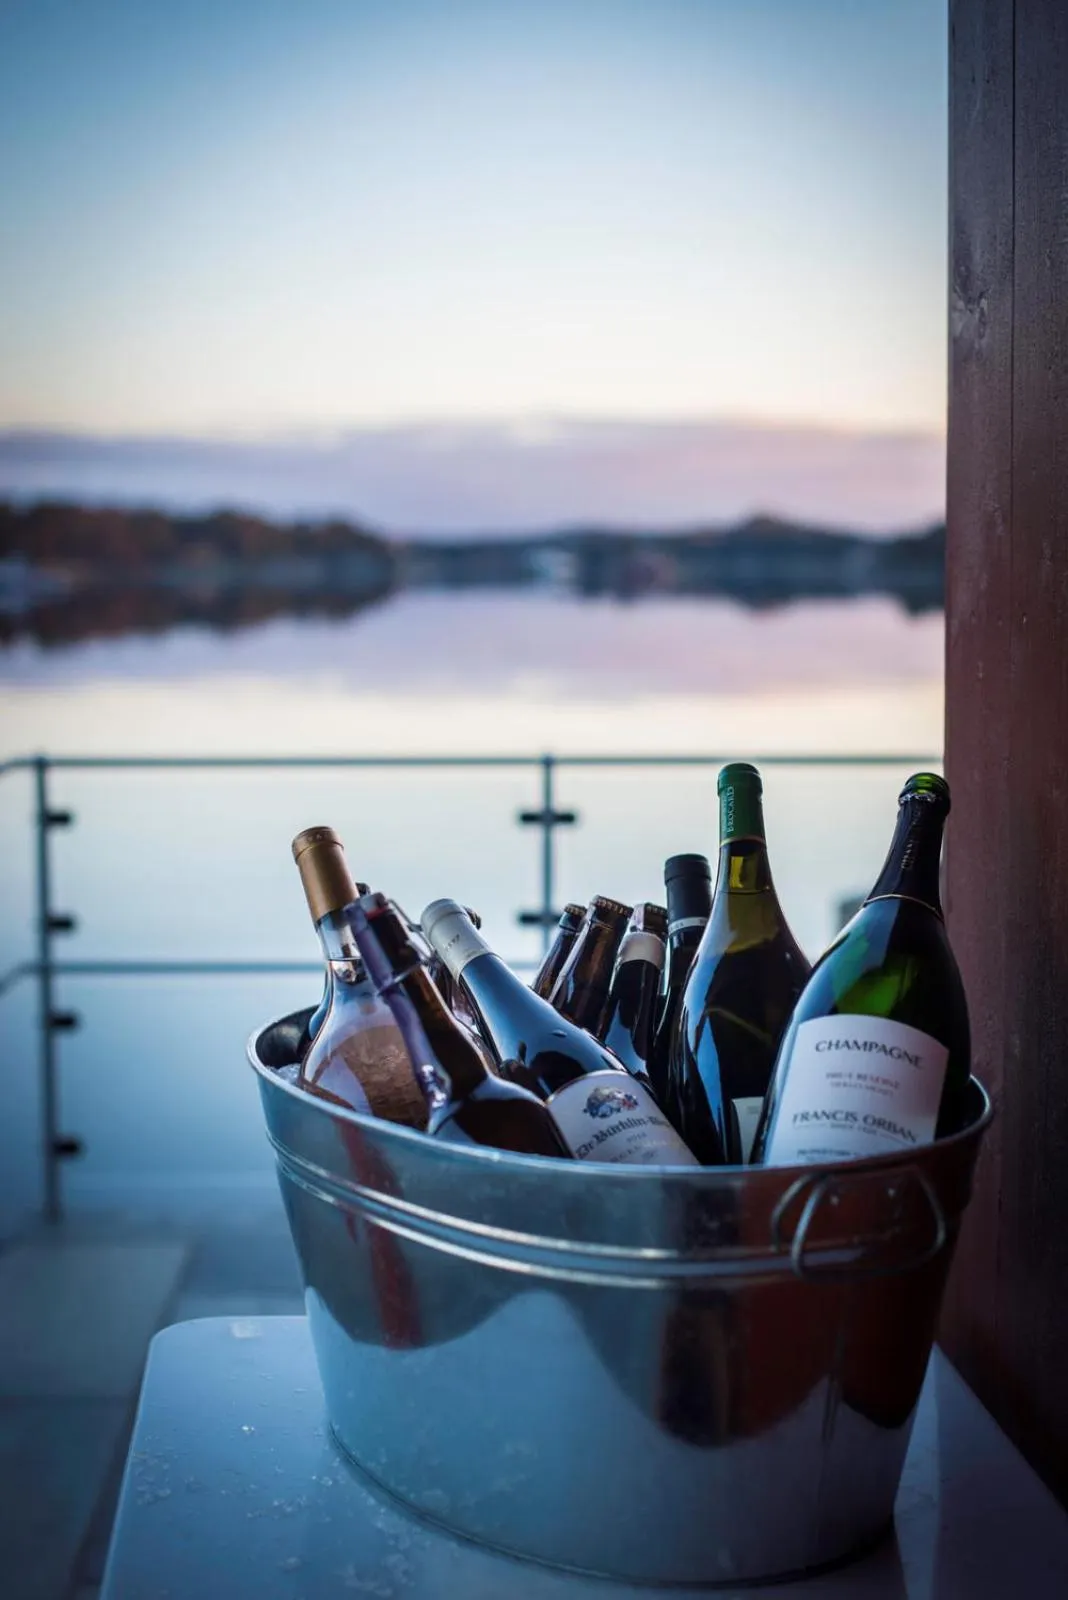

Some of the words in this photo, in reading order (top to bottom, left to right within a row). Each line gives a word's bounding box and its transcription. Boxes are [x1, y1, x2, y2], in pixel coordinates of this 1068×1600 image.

[815, 1039, 924, 1068] CHAMPAGNE
[793, 1109, 858, 1124] FRANCIS
[862, 1113, 917, 1143] ORBAN
